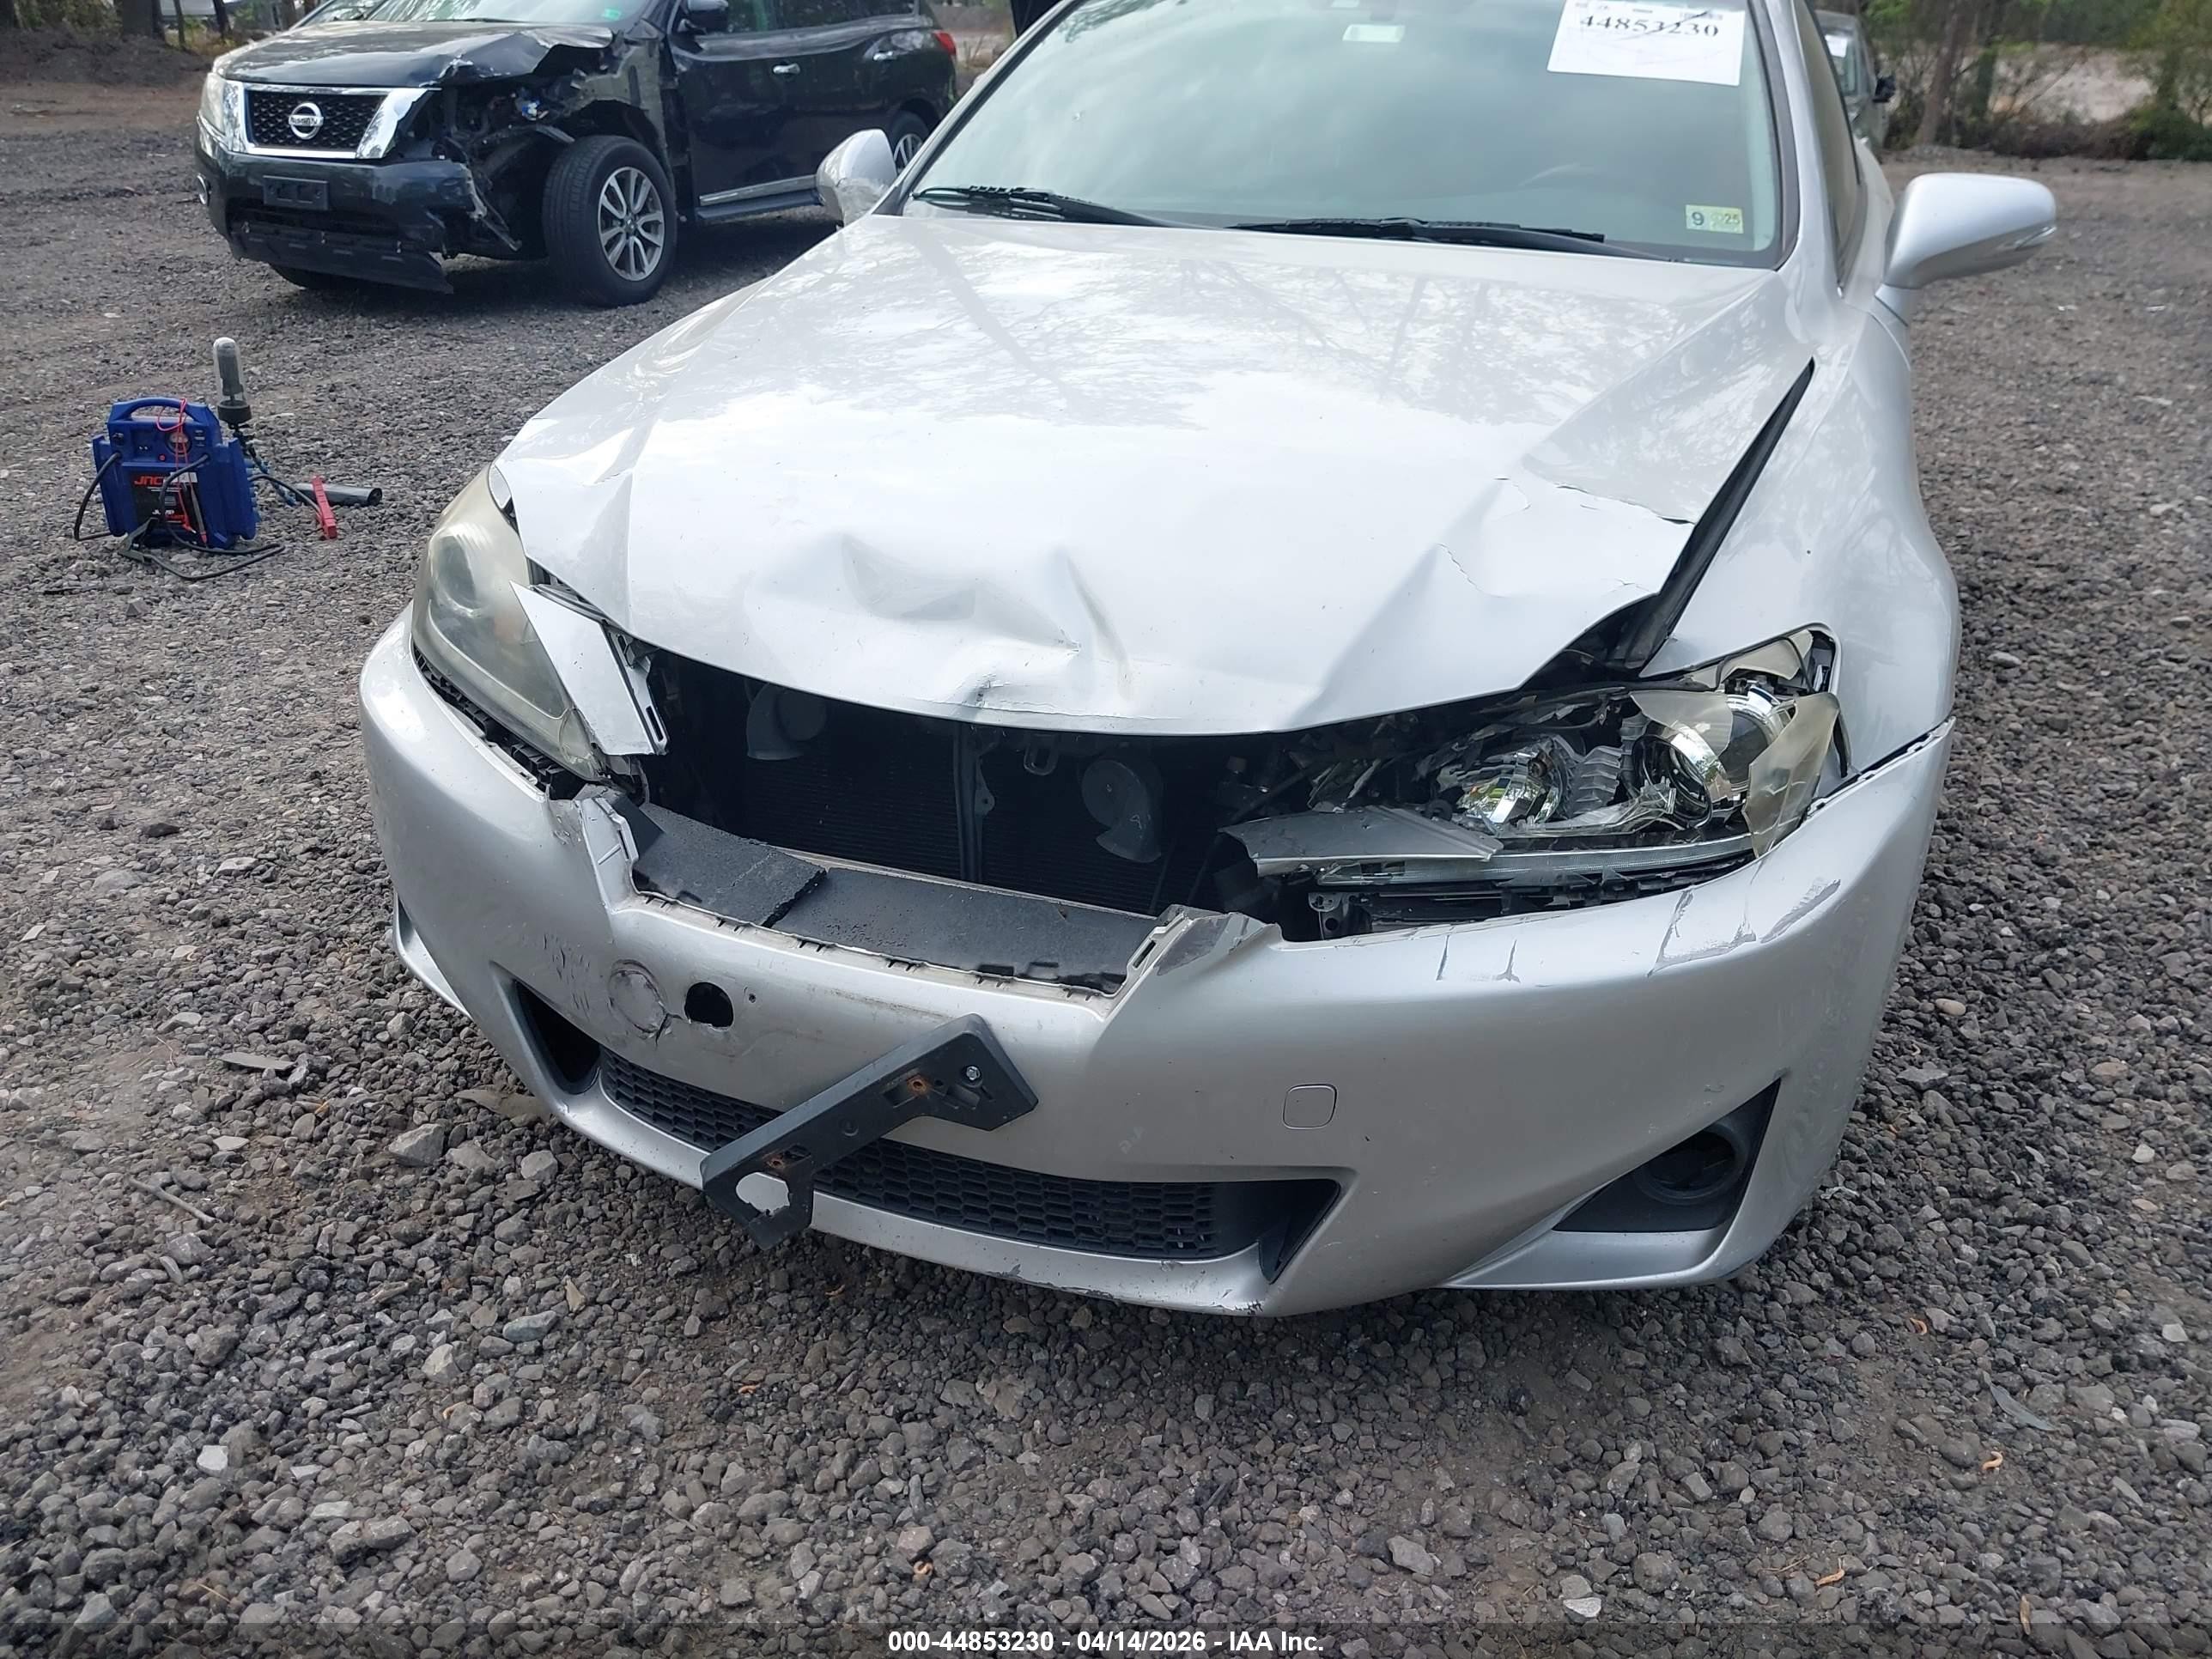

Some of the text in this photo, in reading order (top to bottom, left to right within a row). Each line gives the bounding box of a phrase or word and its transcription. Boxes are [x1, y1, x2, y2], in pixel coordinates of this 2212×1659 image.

[1580, 15, 1718, 38] 44853230
[1692, 211, 1741, 226] 9 25
